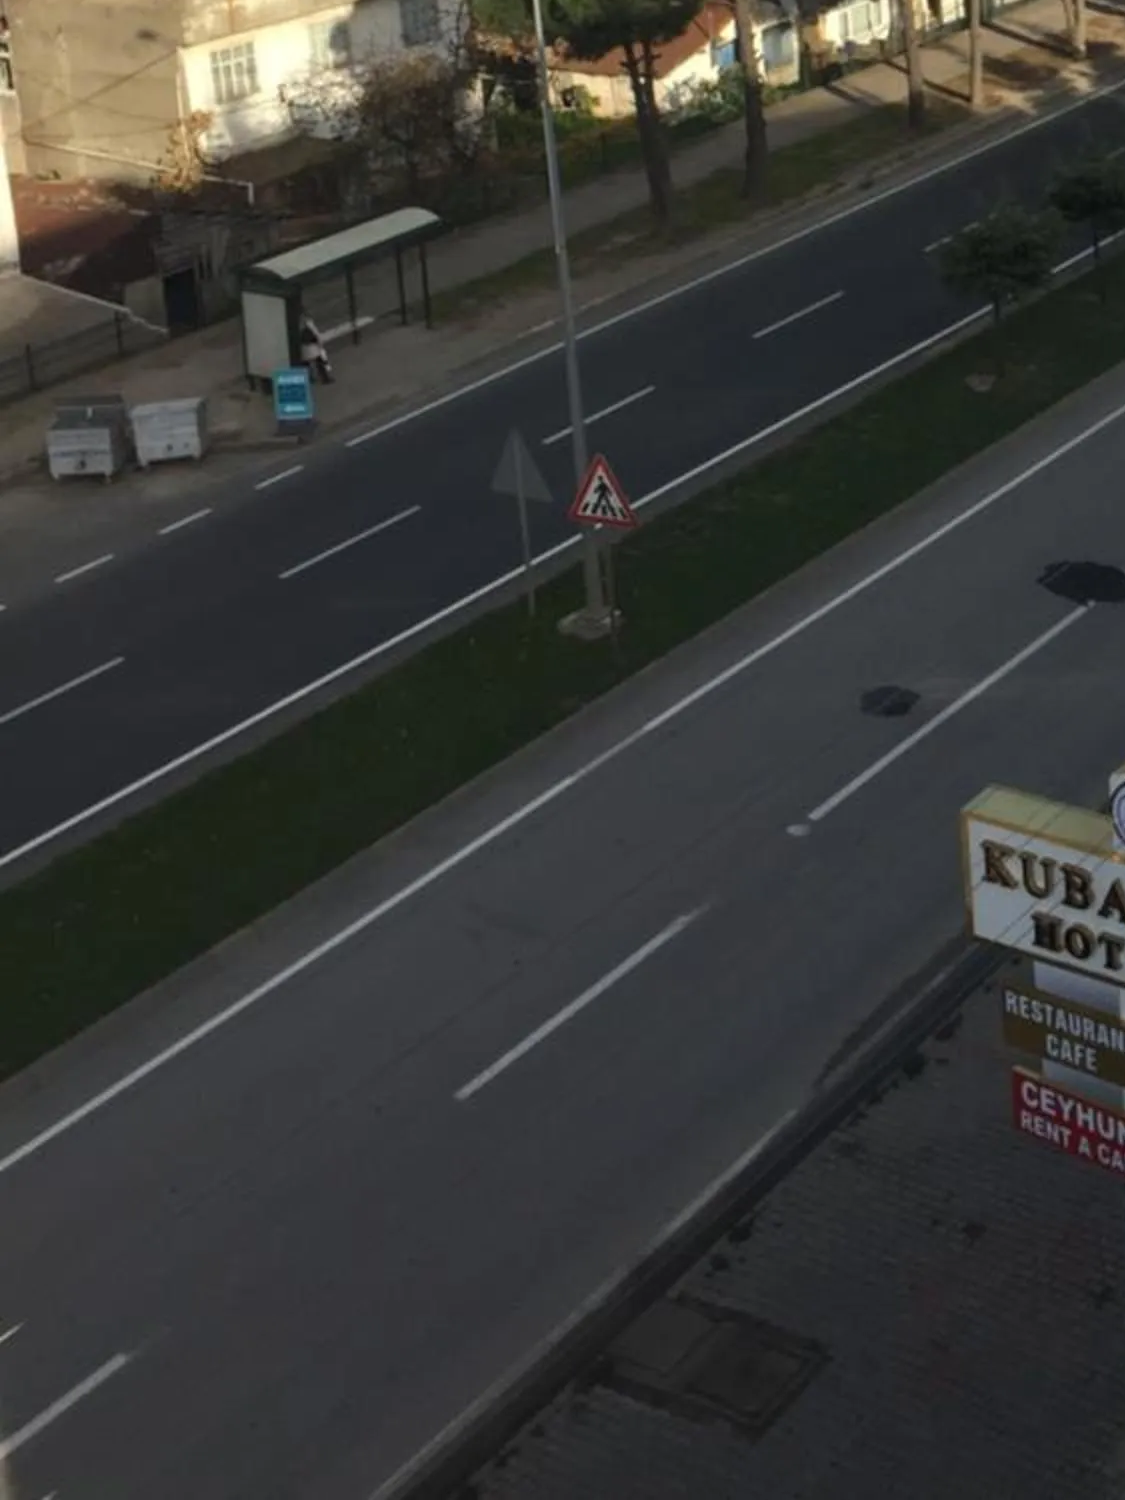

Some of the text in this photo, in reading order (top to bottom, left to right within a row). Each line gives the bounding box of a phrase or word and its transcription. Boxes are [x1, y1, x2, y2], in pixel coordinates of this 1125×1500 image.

[1045, 1033, 1098, 1072] CAFE
[1020, 1110, 1072, 1149] RENT
[1078, 1136, 1091, 1157] A
